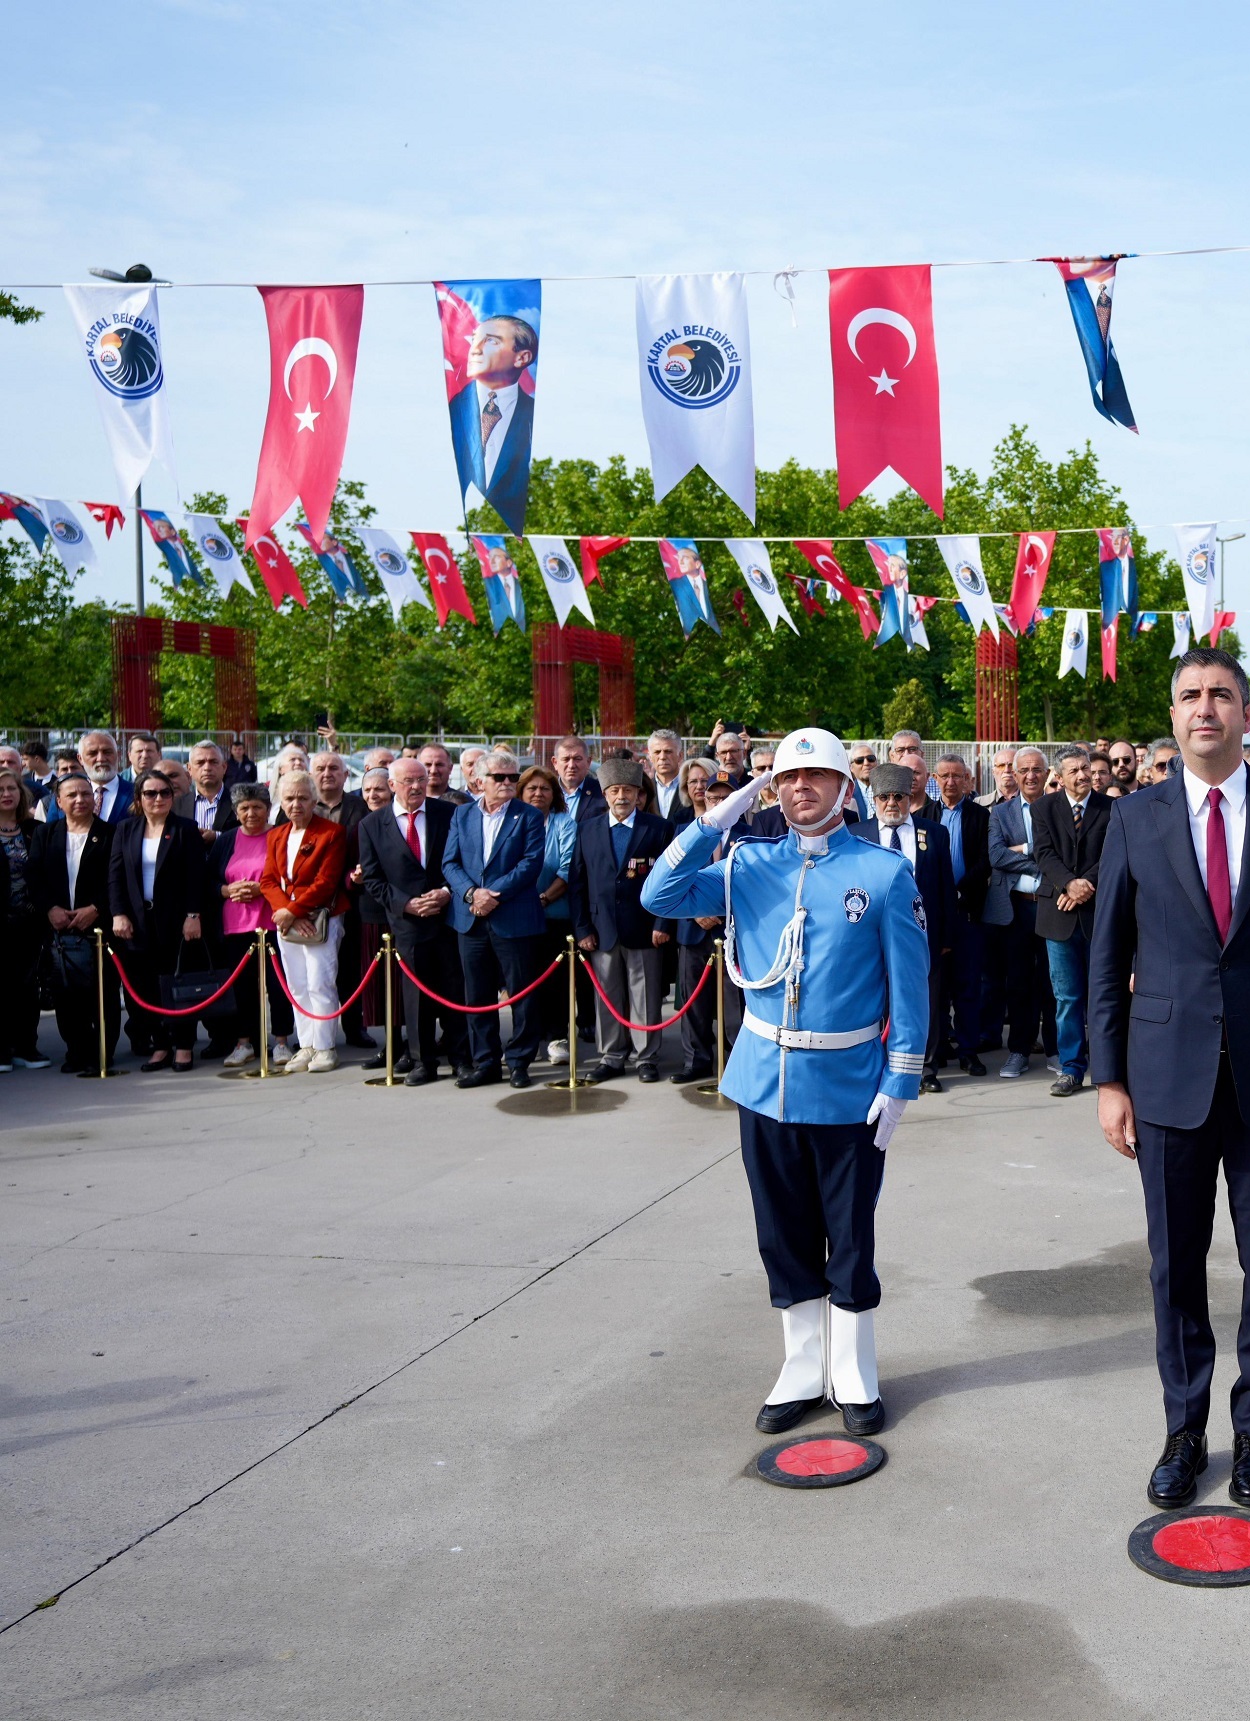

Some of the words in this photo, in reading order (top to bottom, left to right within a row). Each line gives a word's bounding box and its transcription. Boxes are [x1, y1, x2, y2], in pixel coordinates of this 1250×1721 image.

[85, 317, 112, 358] KARTAL
[647, 328, 682, 365] KARTAL
[683, 324, 742, 364] BELEDİYESİ
